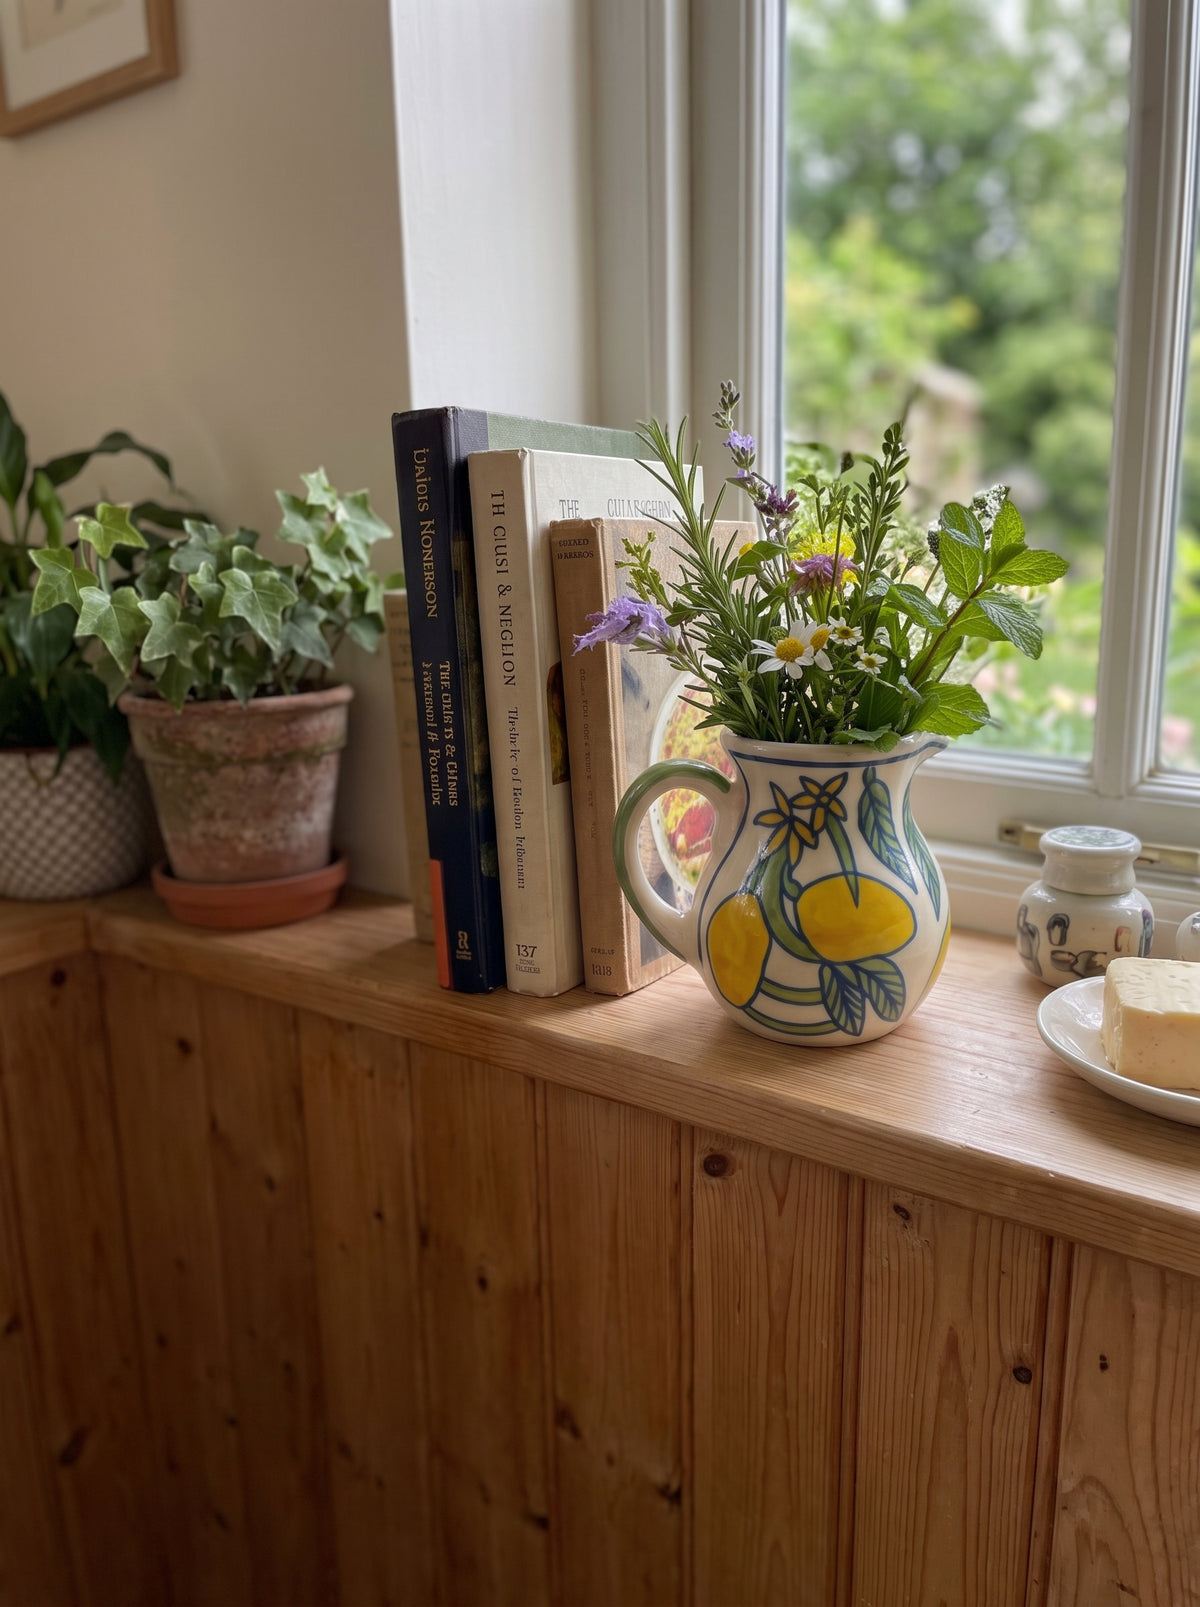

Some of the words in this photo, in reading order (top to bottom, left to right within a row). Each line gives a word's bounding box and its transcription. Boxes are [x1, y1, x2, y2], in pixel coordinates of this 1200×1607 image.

[559, 499, 579, 519] THE
[497, 583, 513, 599] &
[445, 743, 456, 758] &
[515, 943, 538, 958] 137
